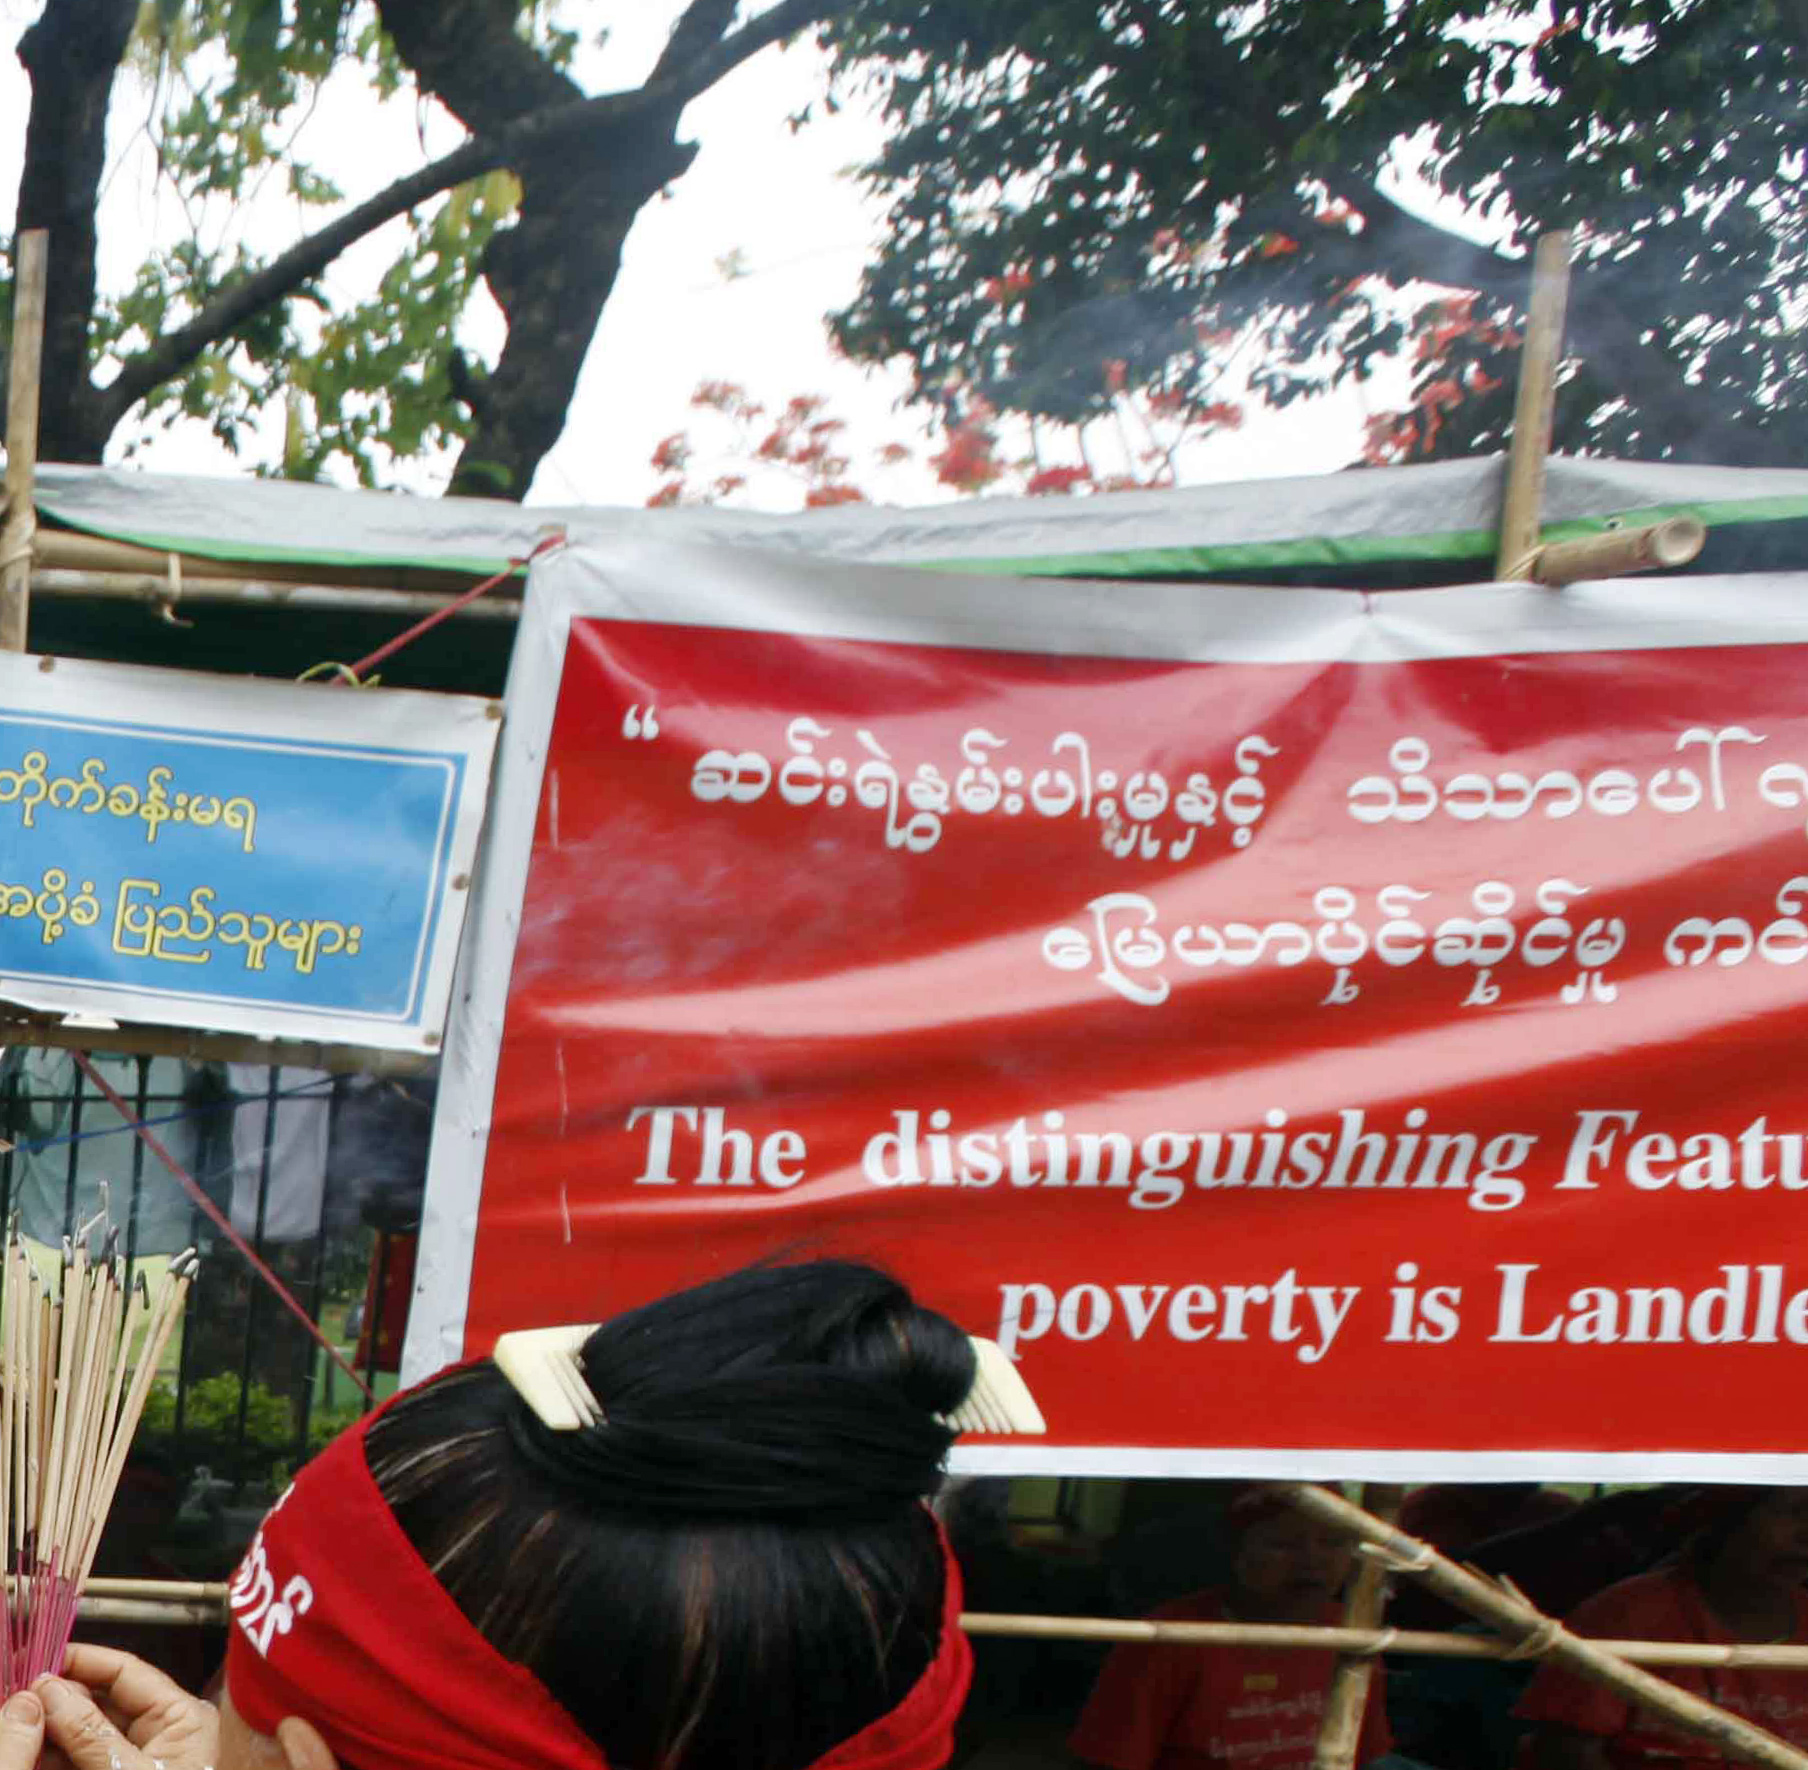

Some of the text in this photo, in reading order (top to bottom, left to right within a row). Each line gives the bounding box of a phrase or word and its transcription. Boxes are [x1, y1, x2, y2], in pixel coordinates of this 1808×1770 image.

[112, 878, 363, 974] ပြည်သူများ
[627, 1106, 806, 1187] The
[861, 1106, 1537, 1210] distinguishing
[997, 1270, 1360, 1363] poverty
[1388, 1263, 1462, 1343] is
